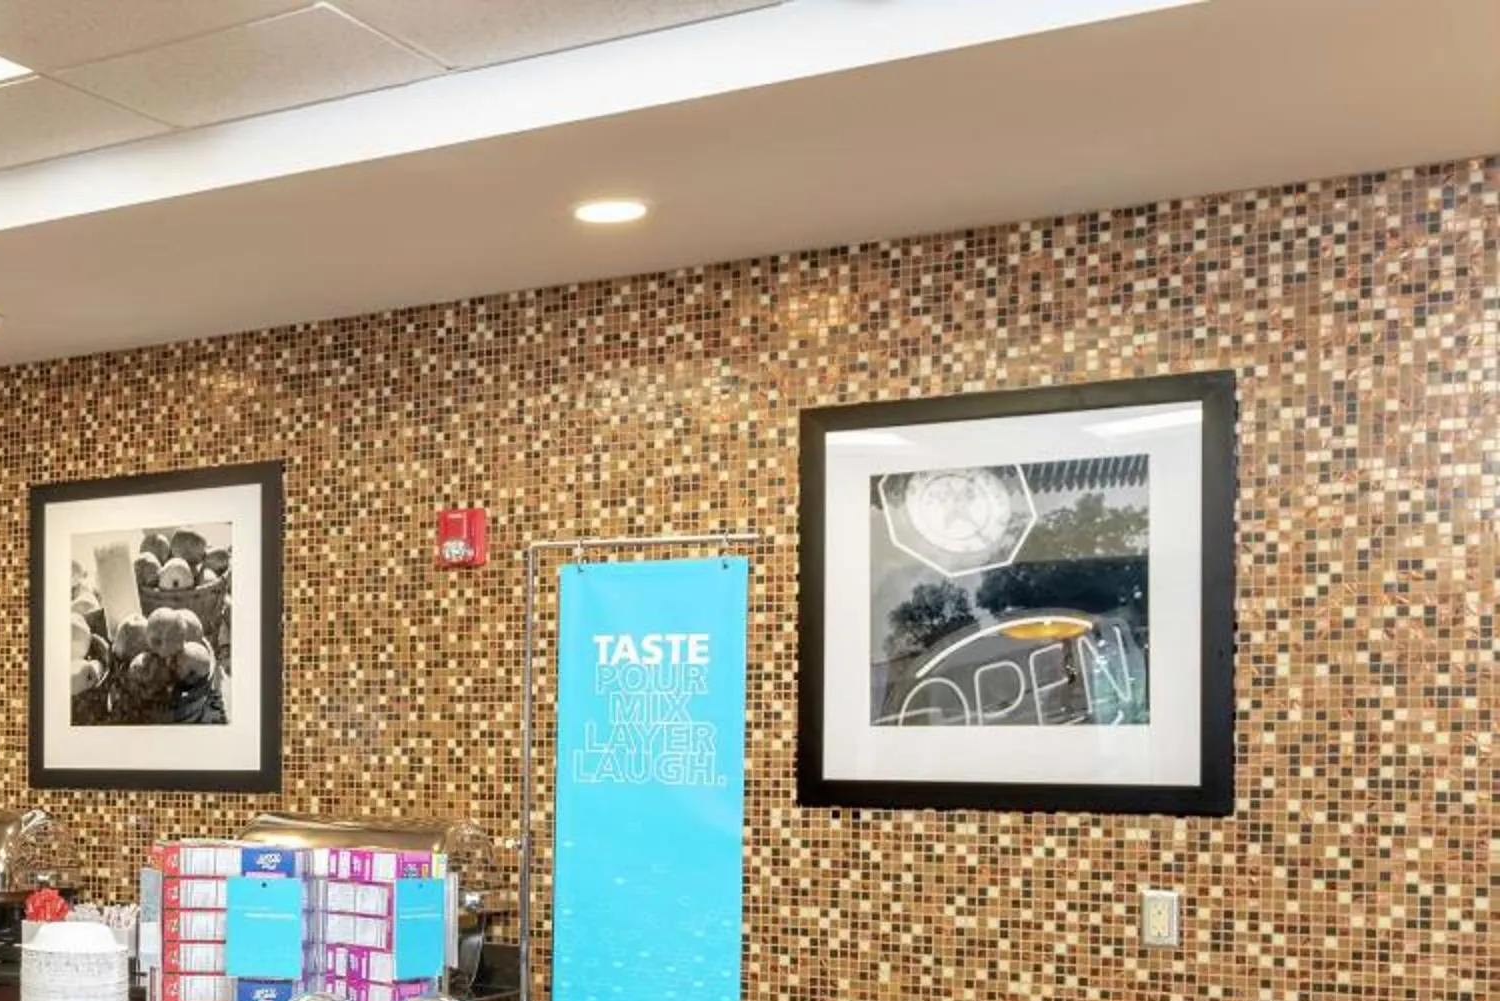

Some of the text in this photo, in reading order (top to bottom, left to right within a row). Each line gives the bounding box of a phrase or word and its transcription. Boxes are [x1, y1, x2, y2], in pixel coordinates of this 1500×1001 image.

[592, 632, 710, 665] TASTE
[594, 661, 709, 695] POUR
[898, 624, 1134, 726] OPEN
[610, 691, 693, 725] MIX
[585, 719, 717, 757] LAYER
[573, 747, 728, 787] LAUGH.
